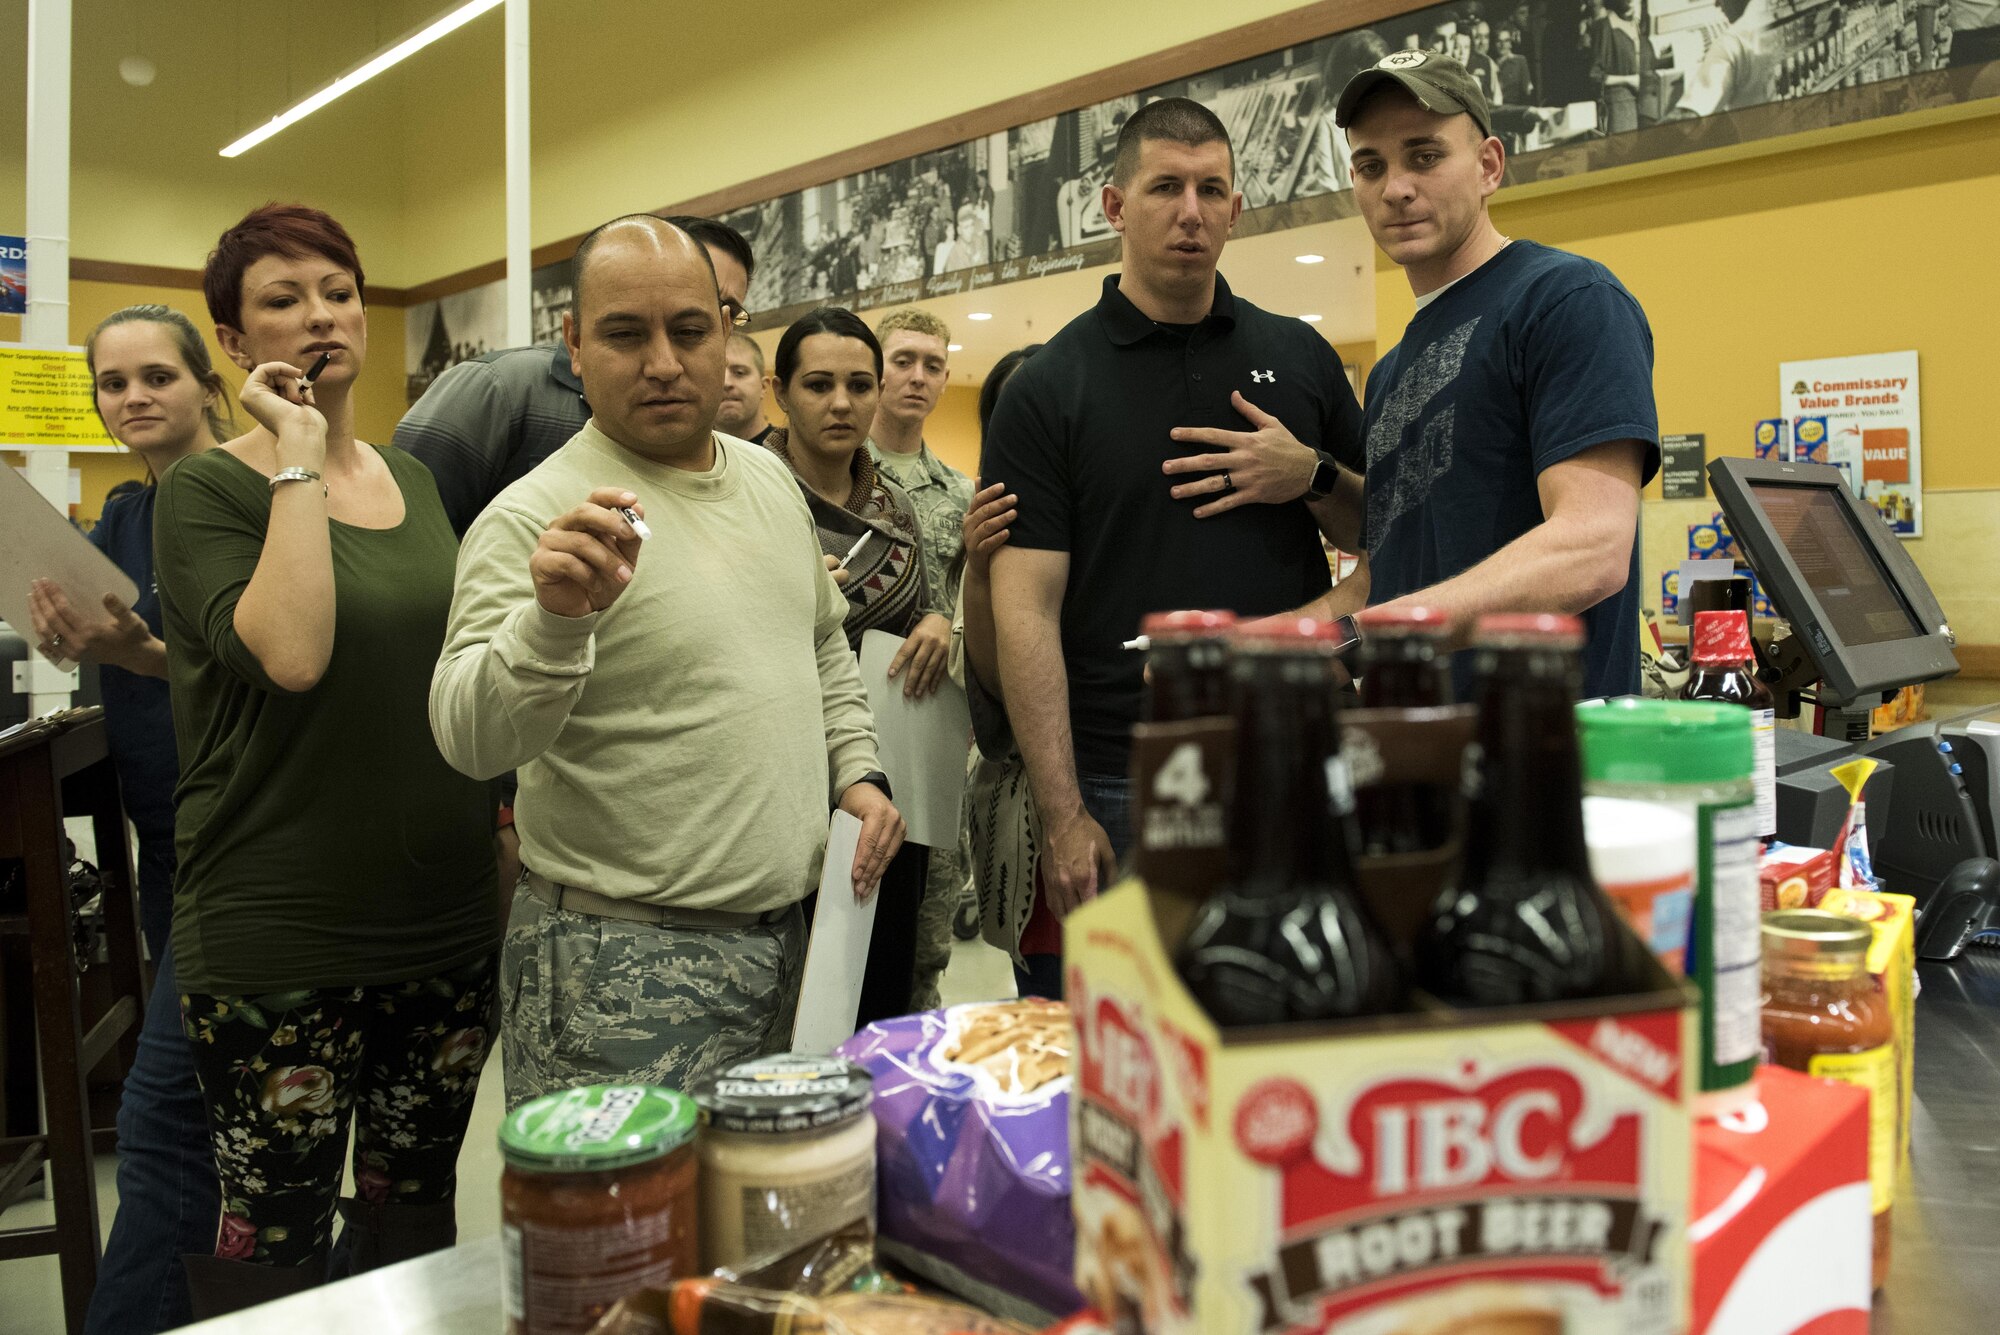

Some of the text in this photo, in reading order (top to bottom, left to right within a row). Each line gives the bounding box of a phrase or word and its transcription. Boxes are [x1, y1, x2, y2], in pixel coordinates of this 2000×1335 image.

[926, 275, 962, 301] Family
[969, 267, 995, 292] from
[1002, 260, 1020, 279] the
[1027, 253, 1085, 277] Beginning
[14, 371, 56, 379] Thanksgiving
[1813, 377, 1908, 393] Commissary
[1799, 392, 1899, 409] Value Brands
[1683, 440, 1700, 448] ROOM
[1863, 447, 1907, 461] VALUE
[1664, 470, 1700, 478] AUTHORIZED
[1664, 477, 1697, 485] PERSONNEL
[1154, 742, 1210, 806] 4
[1589, 1016, 1678, 1088] NEW
[1375, 1090, 1567, 1196] IBC
[1316, 1198, 1614, 1288] ROOT BEER
